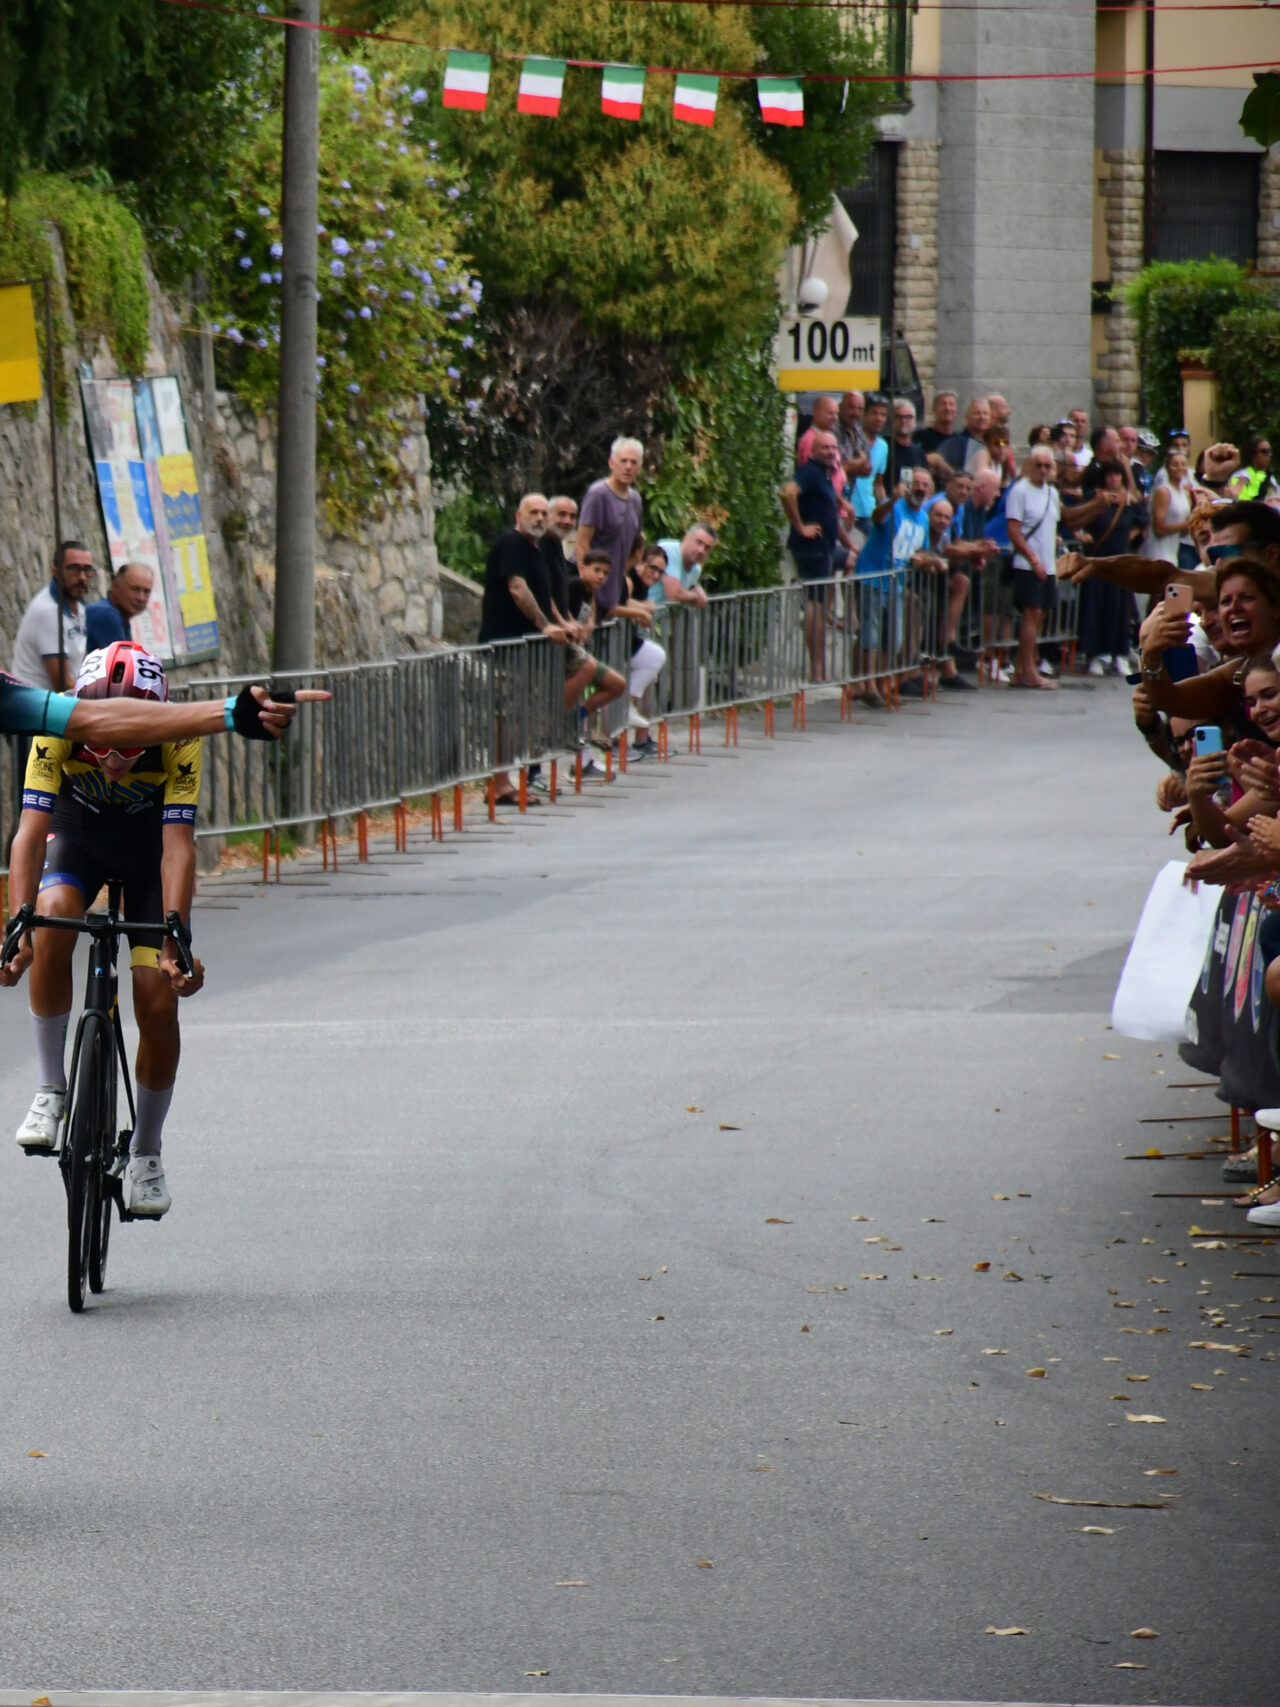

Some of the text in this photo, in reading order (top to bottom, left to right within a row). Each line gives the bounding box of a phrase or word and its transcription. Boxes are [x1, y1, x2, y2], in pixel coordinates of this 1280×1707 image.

[788, 321, 875, 363] 100 mt
[137, 658, 163, 684] 93
